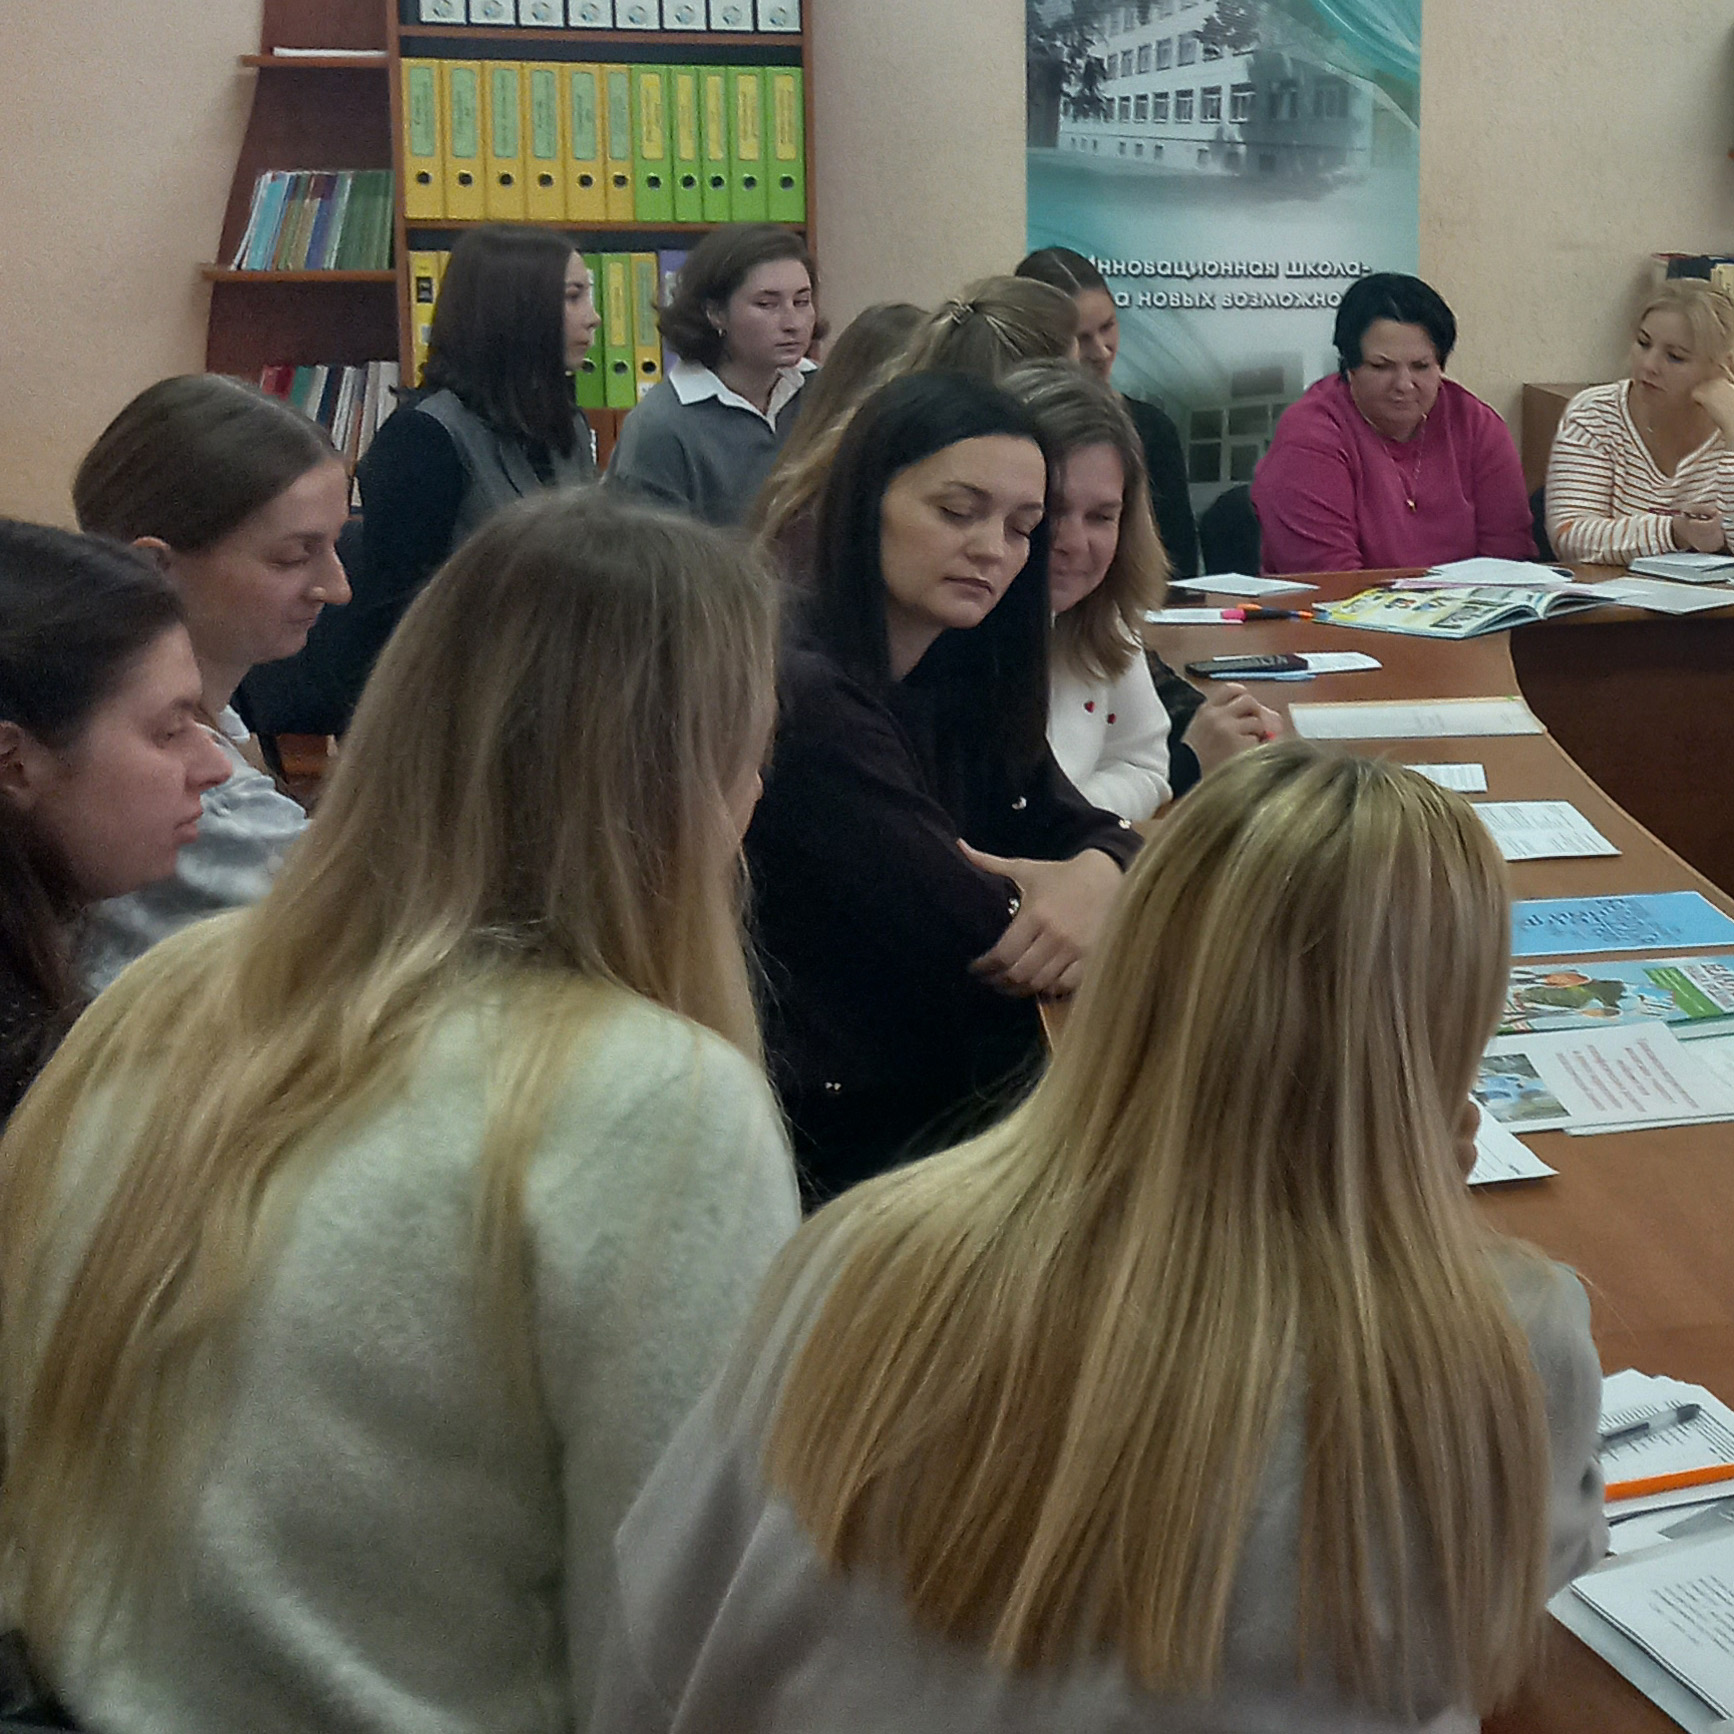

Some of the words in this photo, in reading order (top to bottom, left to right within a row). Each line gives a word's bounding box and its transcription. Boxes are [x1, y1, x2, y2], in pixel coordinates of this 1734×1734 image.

[1114, 291, 1130, 308] а
[1138, 291, 1216, 309] новых
[1222, 292, 1343, 309] возможно
